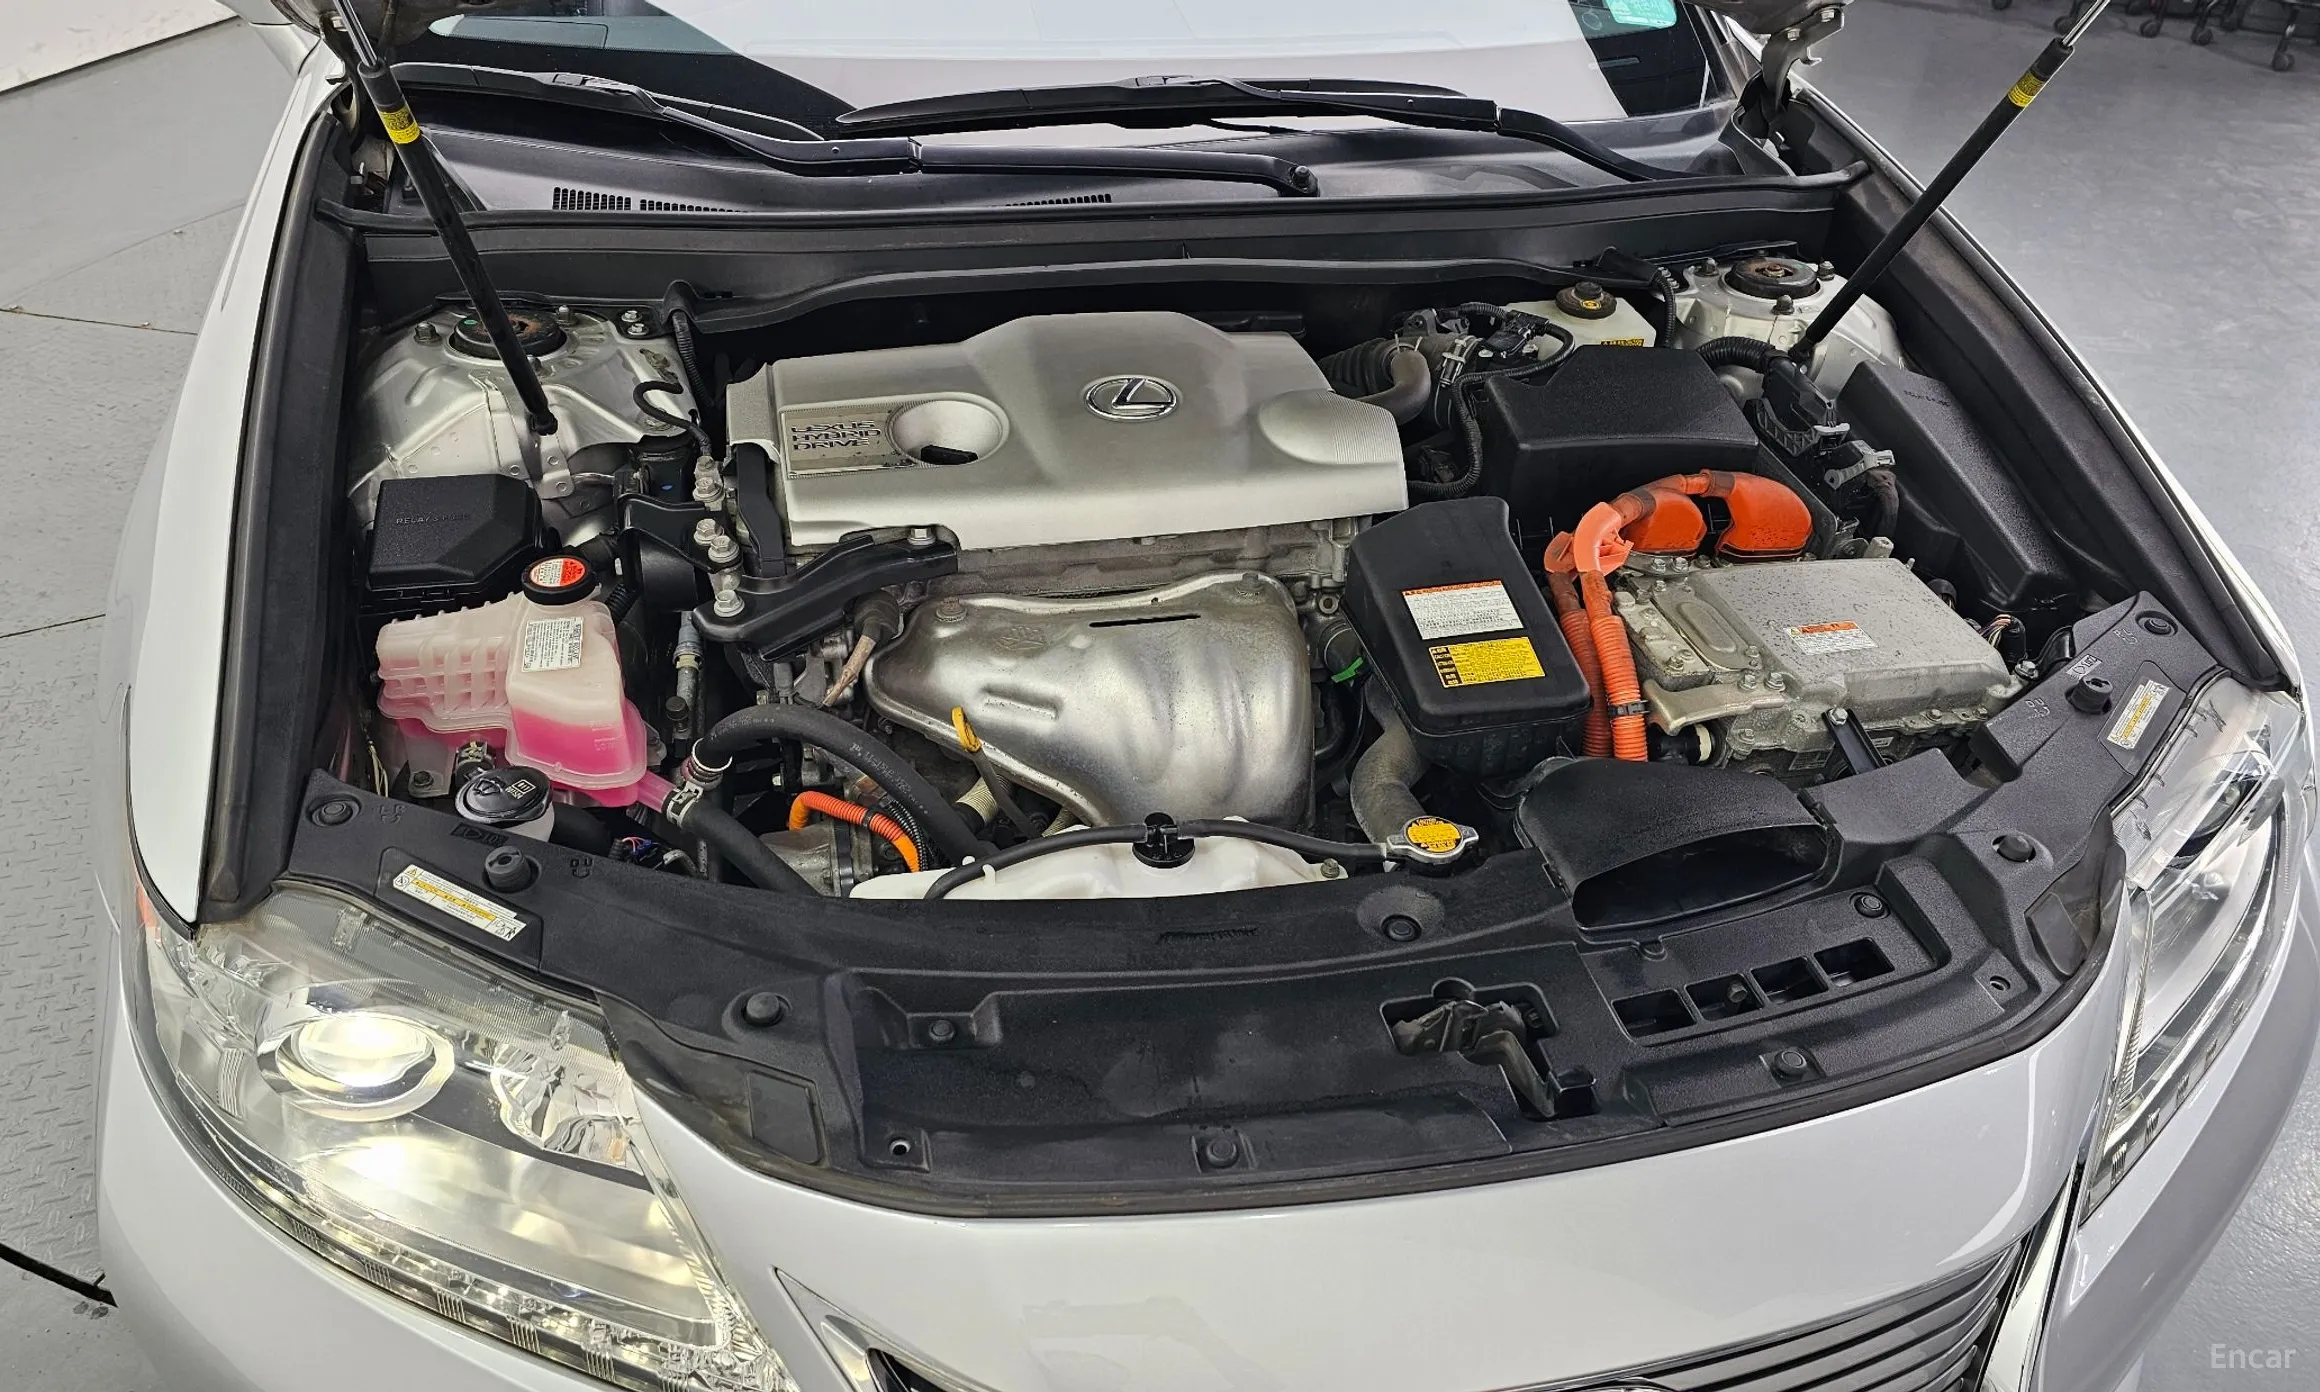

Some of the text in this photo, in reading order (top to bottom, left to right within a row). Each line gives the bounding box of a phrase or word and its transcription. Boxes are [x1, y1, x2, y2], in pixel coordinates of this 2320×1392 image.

[791, 420, 875, 432] LEXUS
[792, 429, 881, 441] HYBRID
[793, 438, 870, 450] DRIVE
